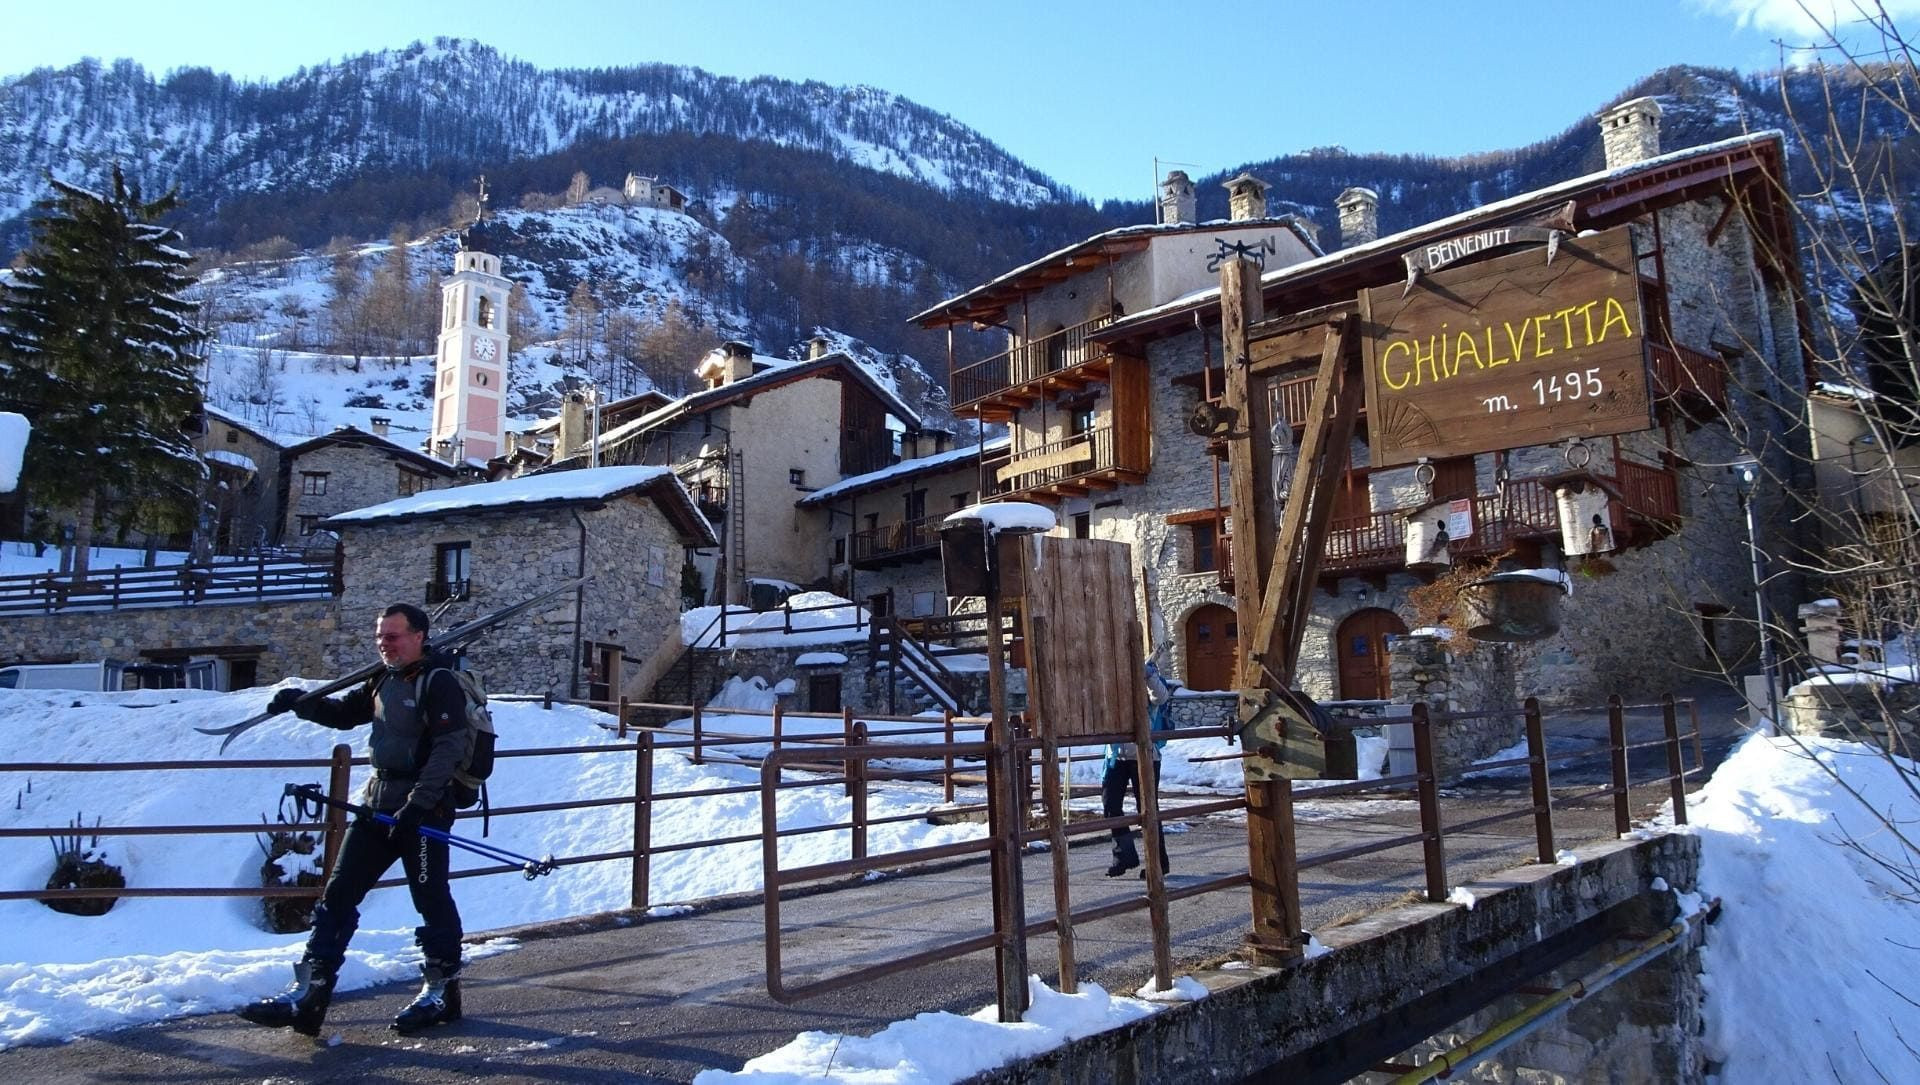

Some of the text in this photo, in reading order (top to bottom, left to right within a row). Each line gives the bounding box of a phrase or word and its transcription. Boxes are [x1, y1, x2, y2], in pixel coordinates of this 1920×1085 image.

[1427, 229, 1510, 270] BENVENUTI
[1482, 367, 1603, 413] m. 1495
[418, 835, 428, 883] Quechua
